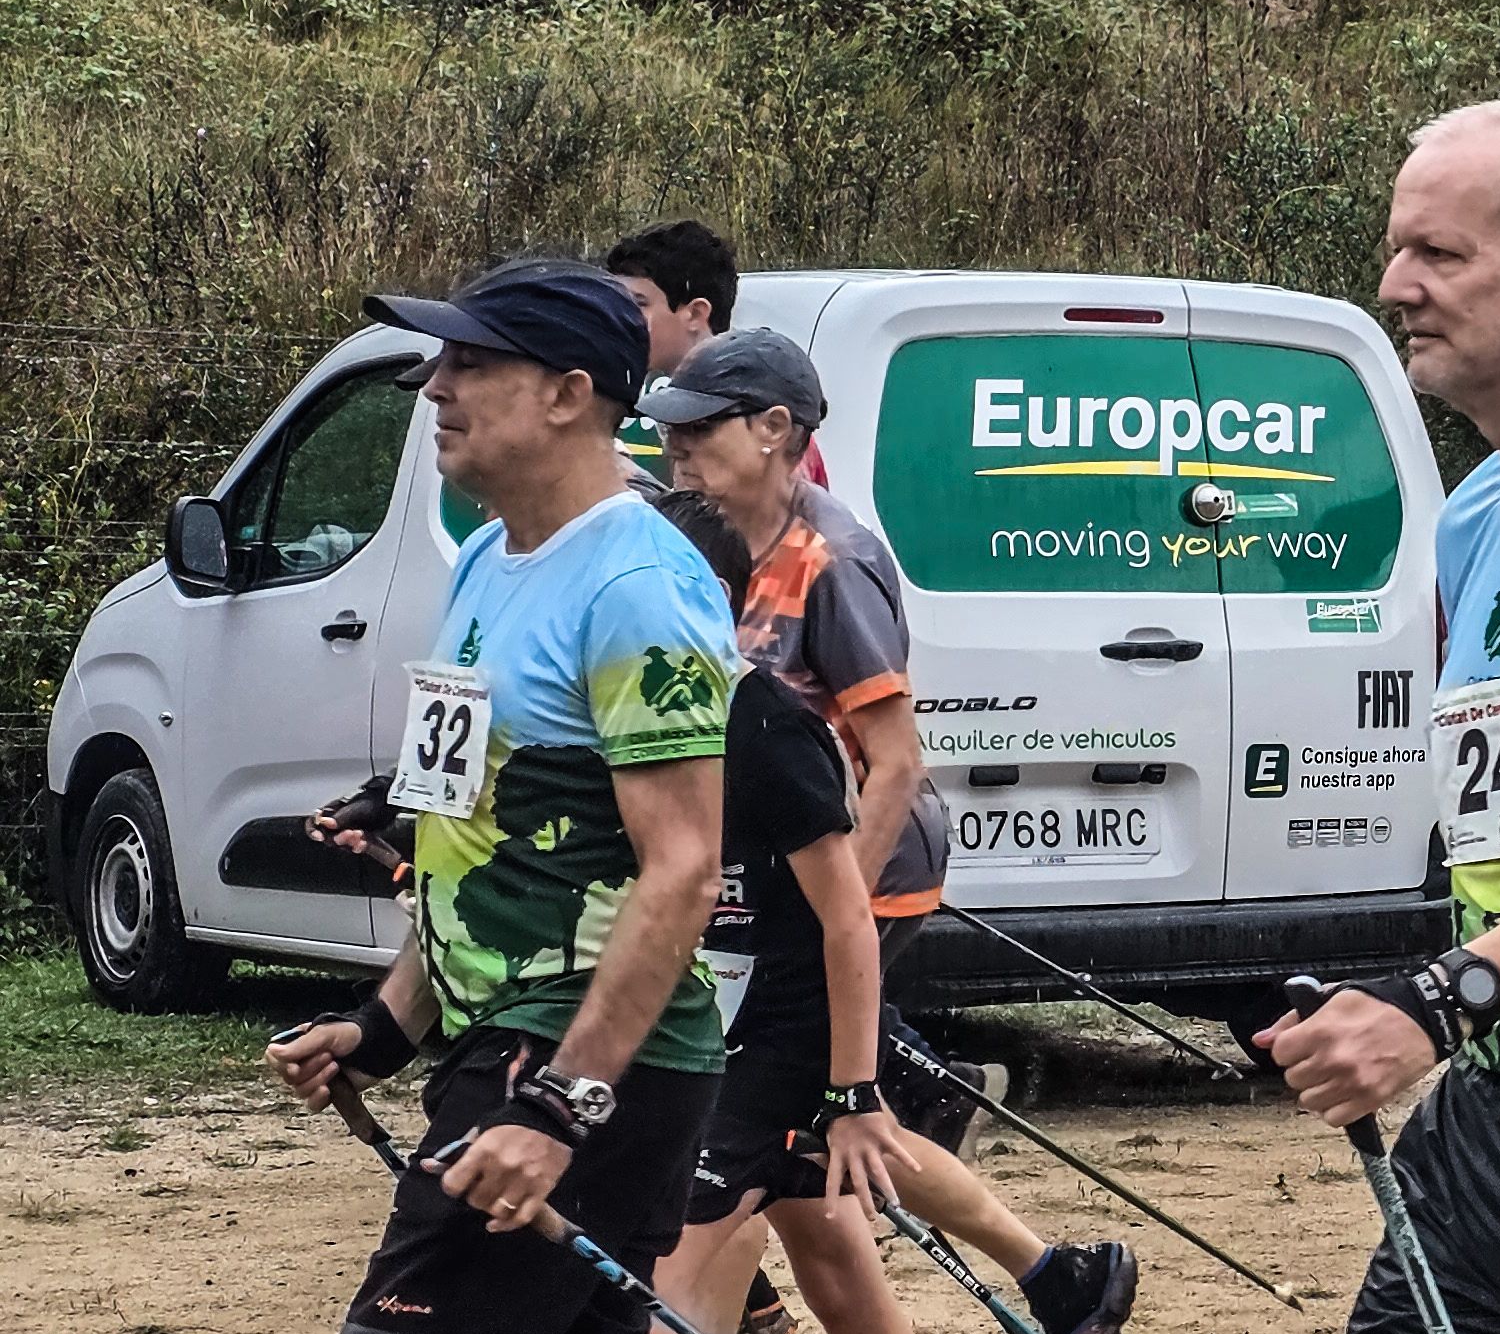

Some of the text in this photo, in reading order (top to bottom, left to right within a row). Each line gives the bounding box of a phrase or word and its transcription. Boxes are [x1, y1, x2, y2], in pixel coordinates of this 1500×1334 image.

[970, 377, 1327, 477] Europcar
[989, 521, 1349, 570] moving your way
[914, 696, 1038, 714] DOBLO
[1357, 670, 1415, 729] FIAT
[416, 699, 473, 777] 32
[919, 729, 1017, 756] lquiler
[1022, 729, 1055, 750] de
[1301, 745, 1426, 768] Consigue ahora
[1300, 771, 1396, 792] nuestra app
[959, 808, 1147, 851] 0768 MRC
[894, 1039, 947, 1078] LEKI
[929, 1245, 986, 1298] GABEL
